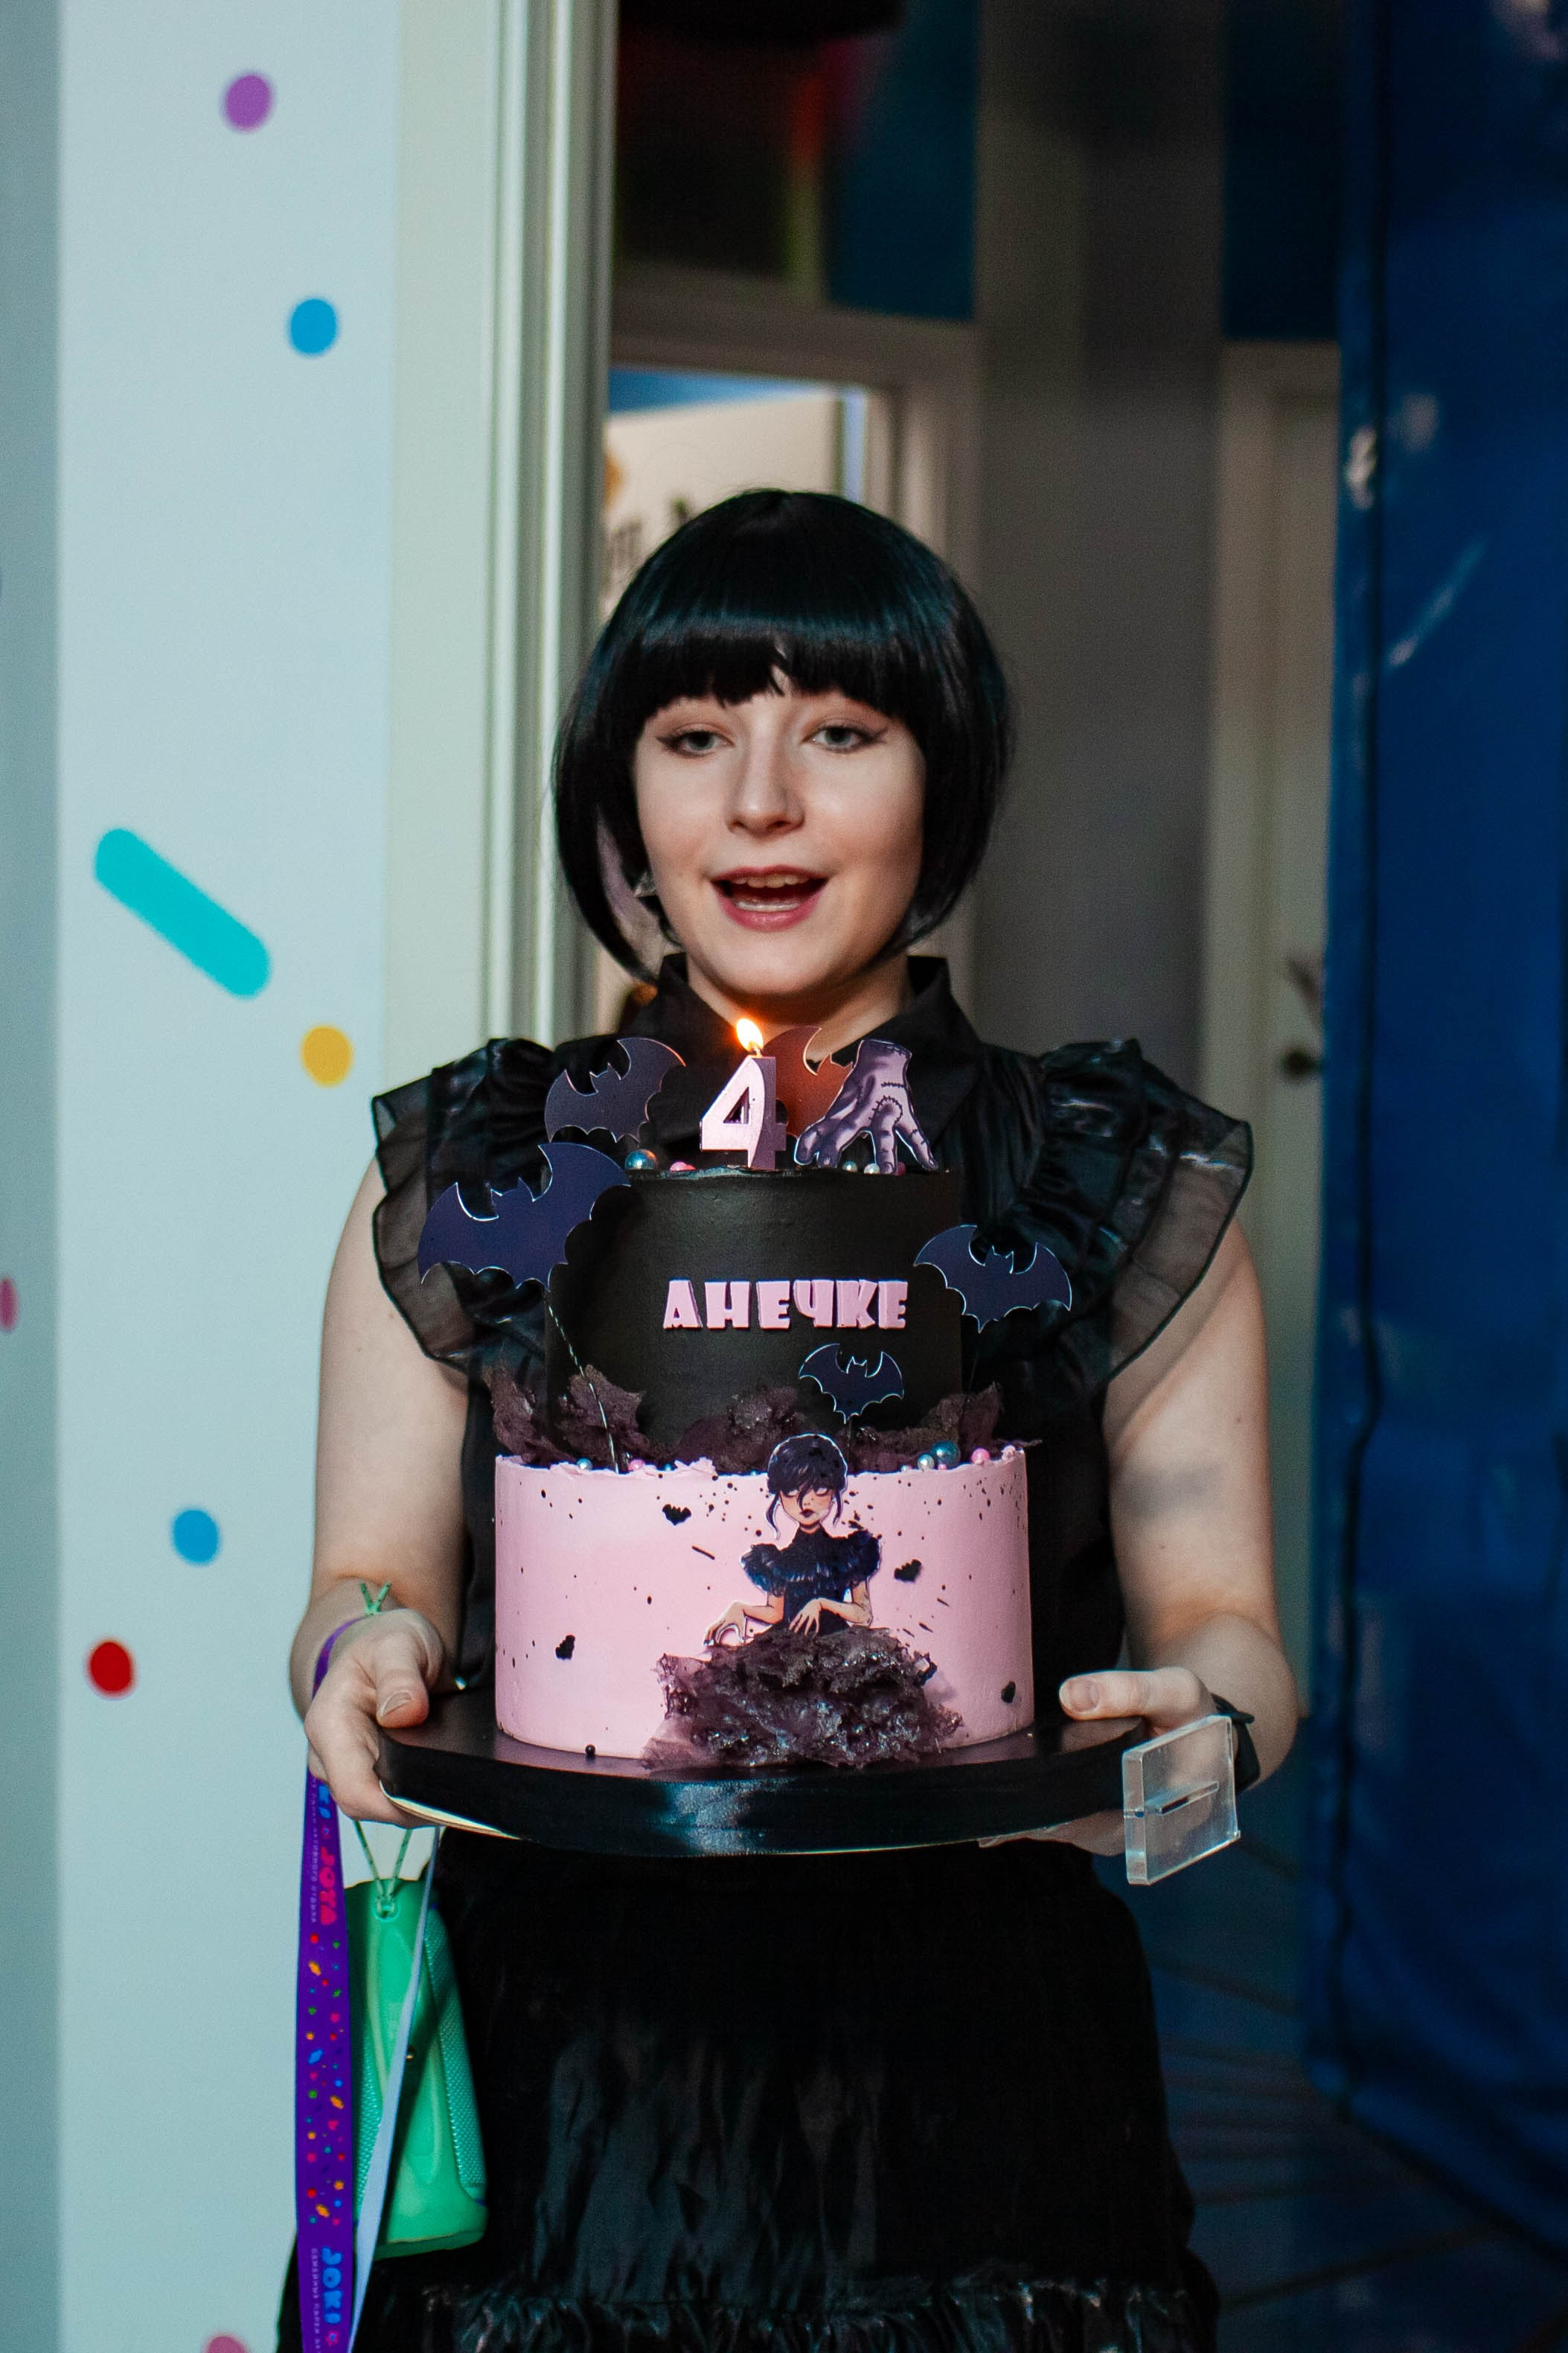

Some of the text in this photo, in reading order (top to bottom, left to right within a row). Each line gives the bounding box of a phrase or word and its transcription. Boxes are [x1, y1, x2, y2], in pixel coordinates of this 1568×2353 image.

[700, 1056, 777, 1169] 4
[663, 1279, 908, 1329] АНЕЧКЕ
[319, 1845, 338, 1925] JOYA
[321, 2247, 343, 2324] JOKI
